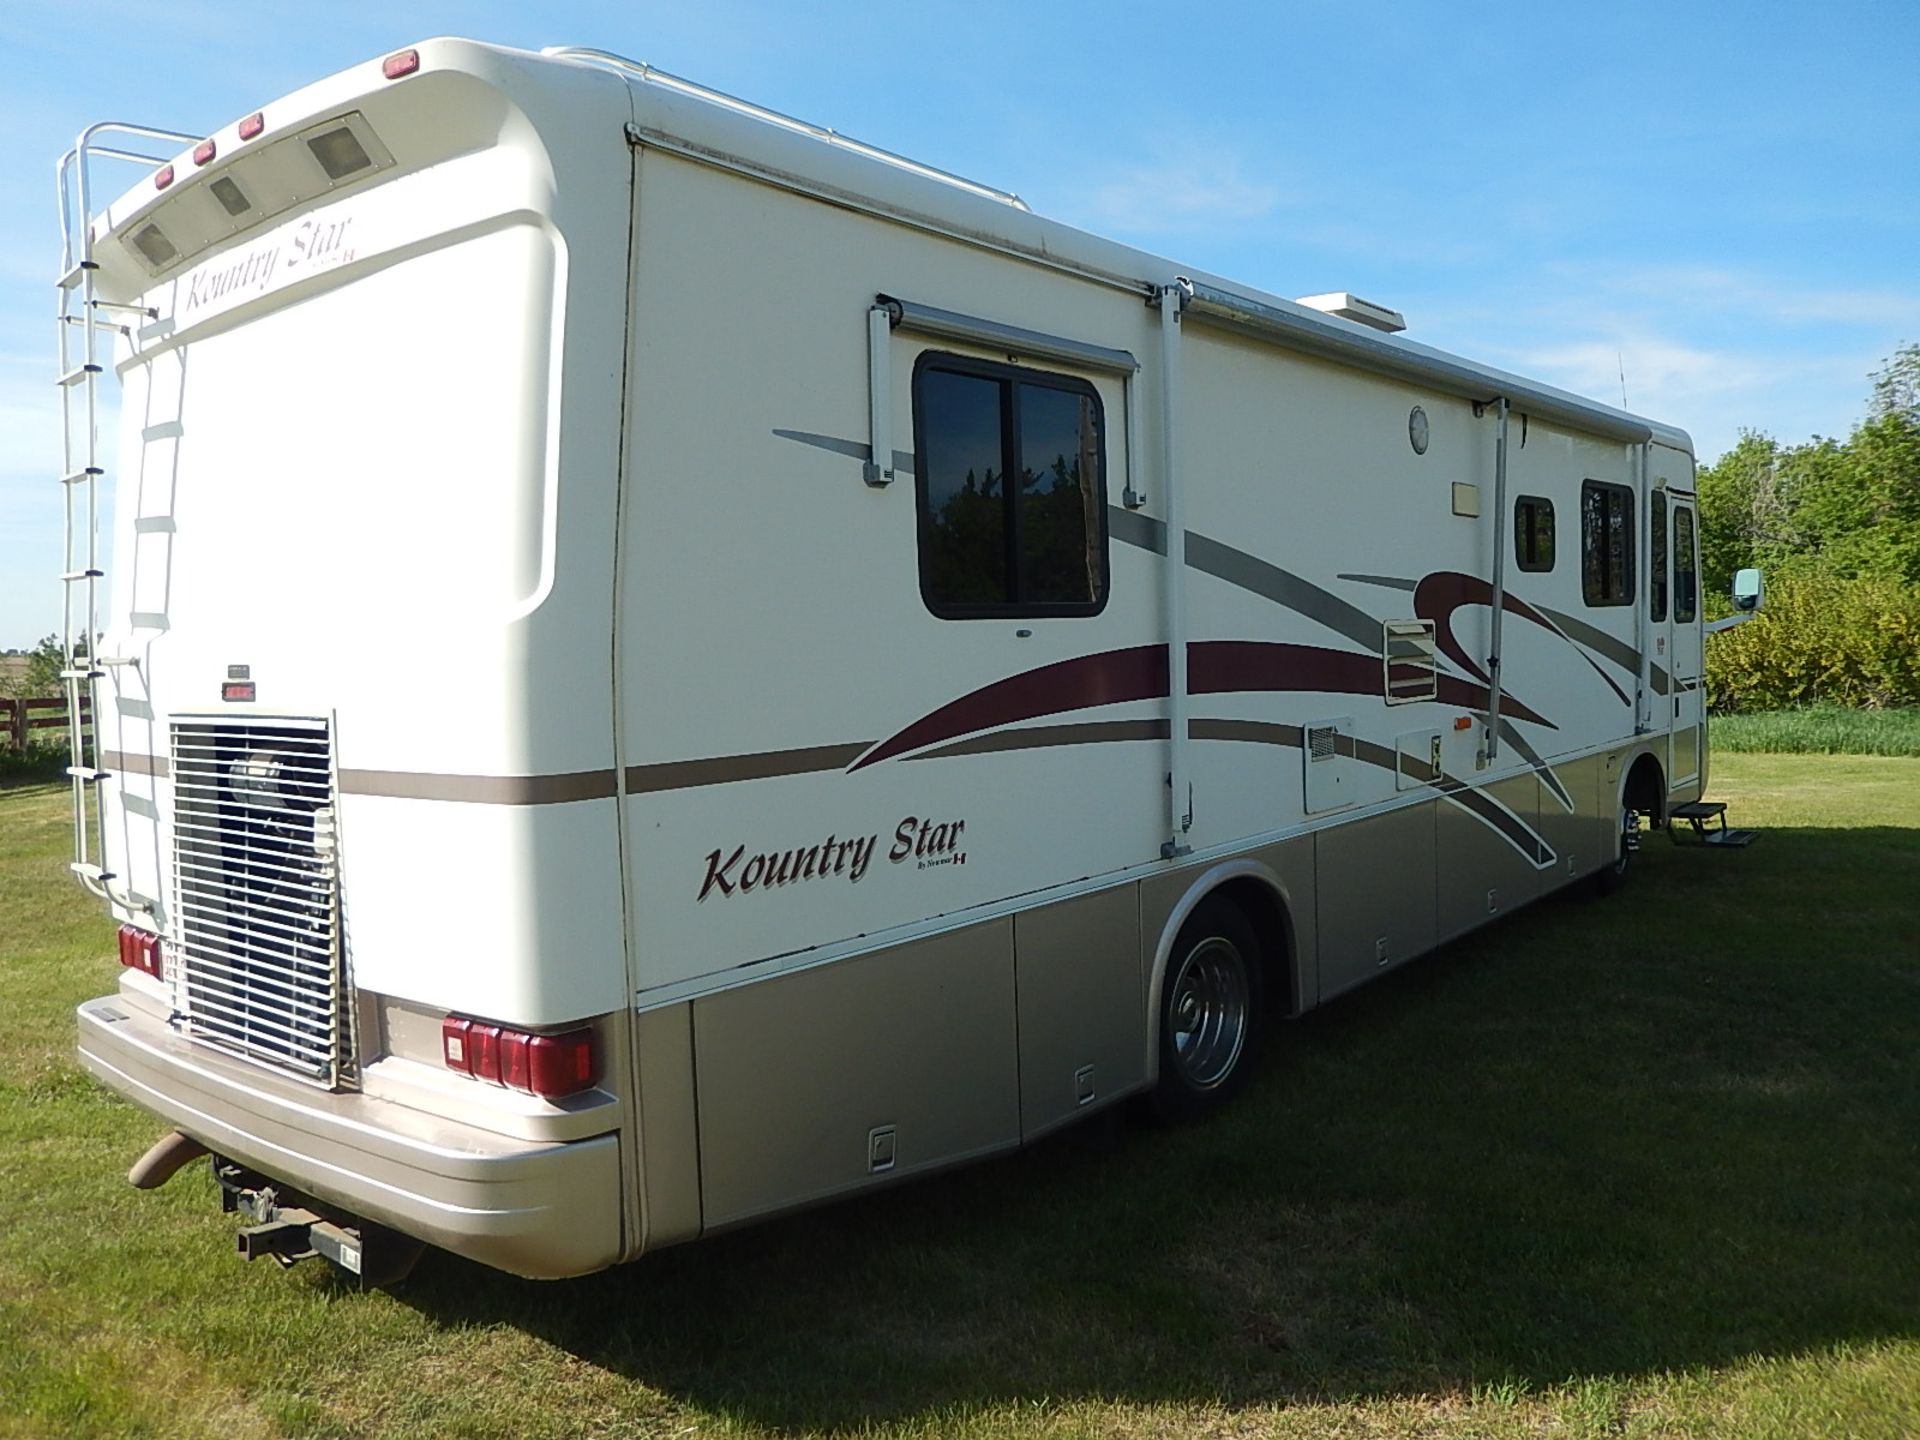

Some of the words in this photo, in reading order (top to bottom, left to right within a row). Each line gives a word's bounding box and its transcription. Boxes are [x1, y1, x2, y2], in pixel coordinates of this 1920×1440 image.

[186, 247, 280, 312] Kountry
[287, 217, 352, 267] Star
[697, 834, 878, 903] Kountry
[889, 816, 965, 864] Star
